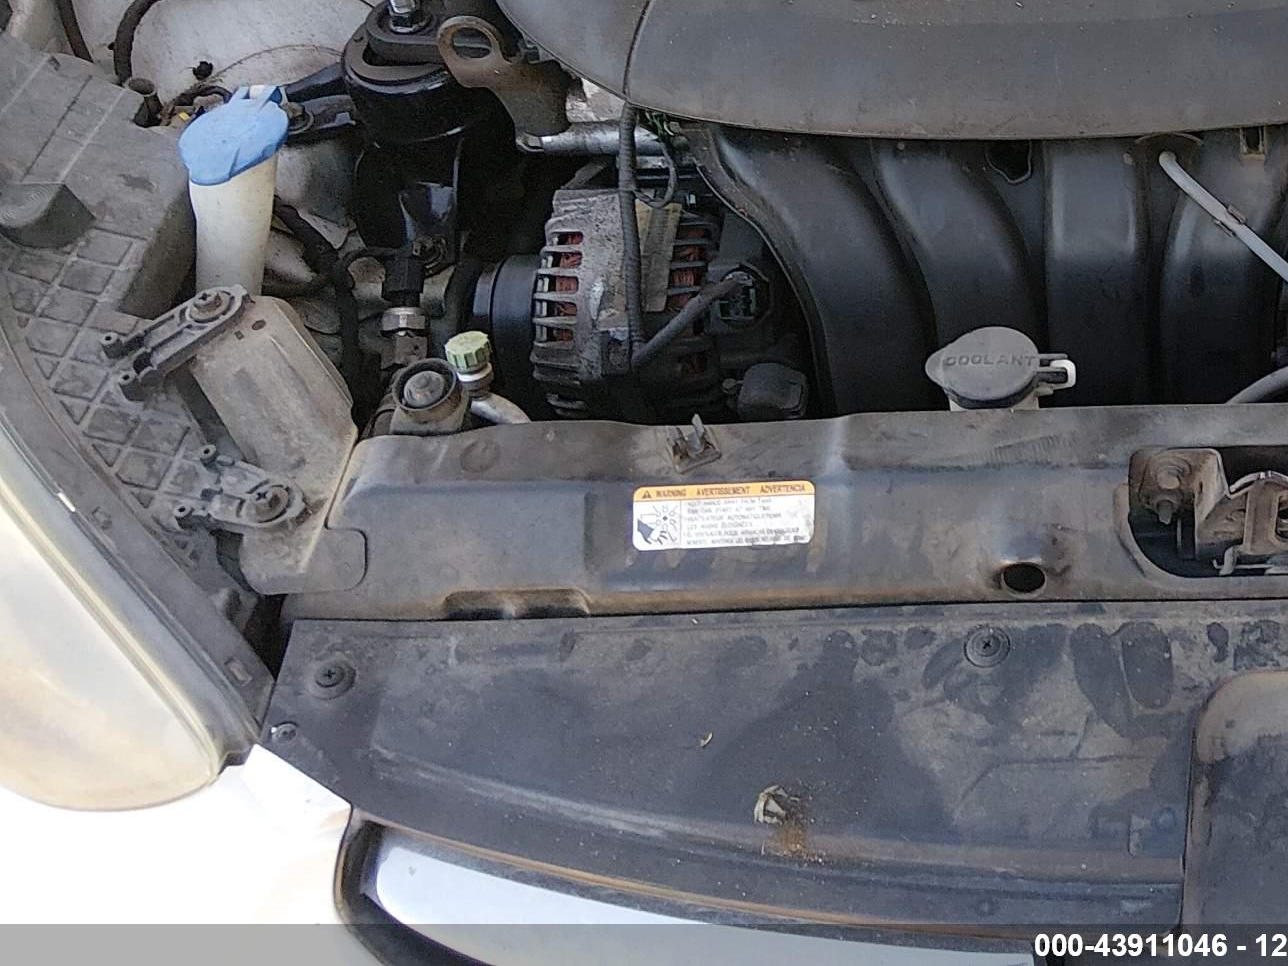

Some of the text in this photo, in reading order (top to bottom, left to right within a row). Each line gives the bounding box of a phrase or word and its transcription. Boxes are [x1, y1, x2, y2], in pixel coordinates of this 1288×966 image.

[943, 354, 1036, 367] COOLANT
[656, 484, 806, 498] WARNING AVERTISSEMENT ADVERTENCIA
